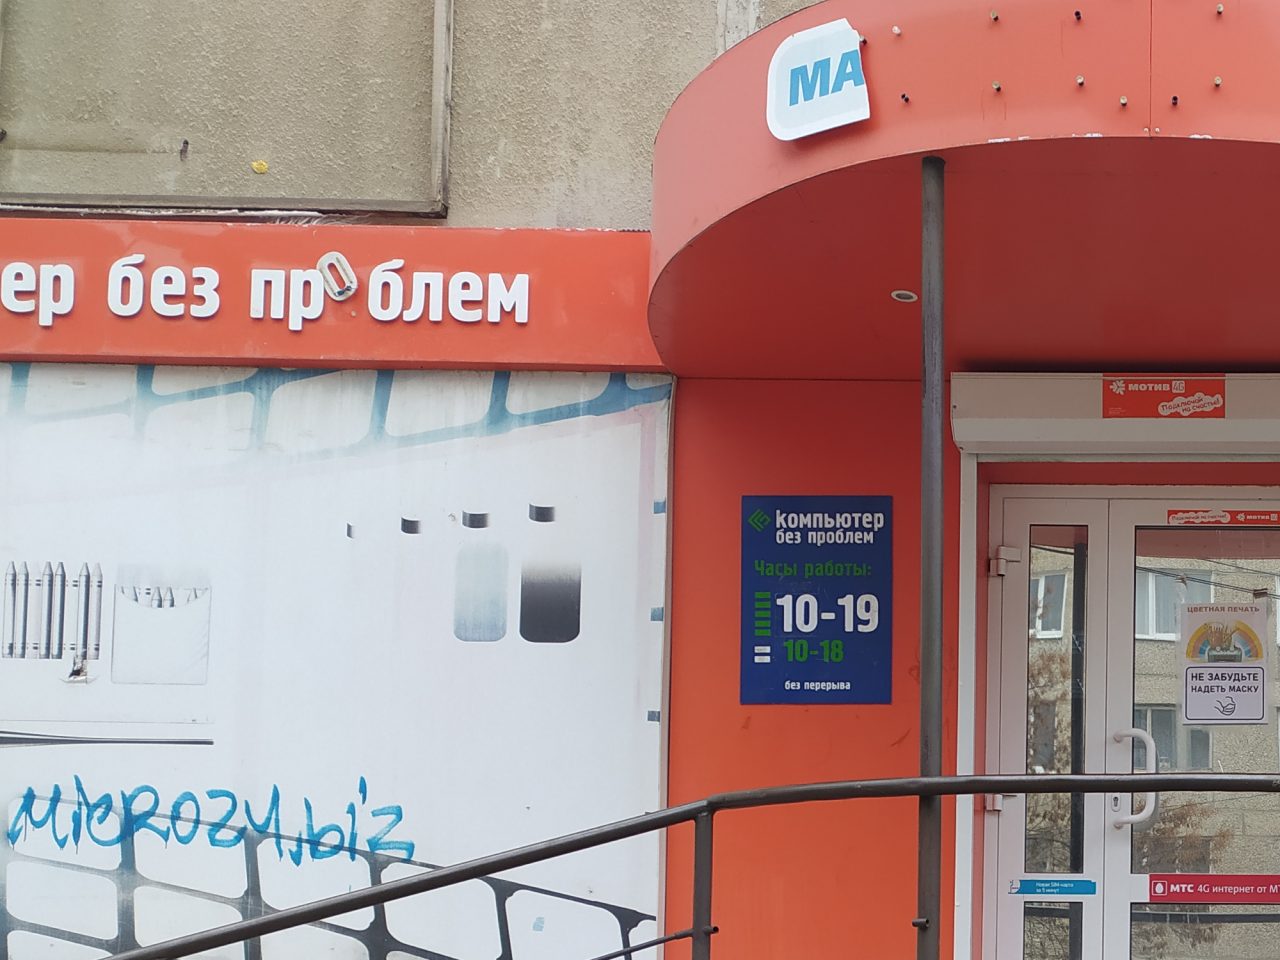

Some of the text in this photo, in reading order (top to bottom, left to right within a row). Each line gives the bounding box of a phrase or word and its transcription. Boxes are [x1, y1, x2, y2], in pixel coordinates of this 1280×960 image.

[107, 253, 221, 318] без
[775, 509, 885, 531] компьютер
[776, 529, 874, 546] без проблем
[754, 560, 872, 578] Часы работы:
[776, 593, 879, 633] 10-19
[1187, 605, 1260, 614] ЦВЕТНАЯ ПЕЧАТЬ
[784, 638, 845, 663] 10-18
[784, 680, 851, 692] без перерыва
[1191, 672, 1259, 683] НЕ ЗАБУДЬТЕ
[1191, 685, 1259, 694] НАДЕТЬ МАСКУ
[1169, 883, 1194, 893] МТС
[1197, 883, 1210, 893] 4G
[1212, 884, 1254, 895] интернет
[1256, 885, 1266, 893] от
